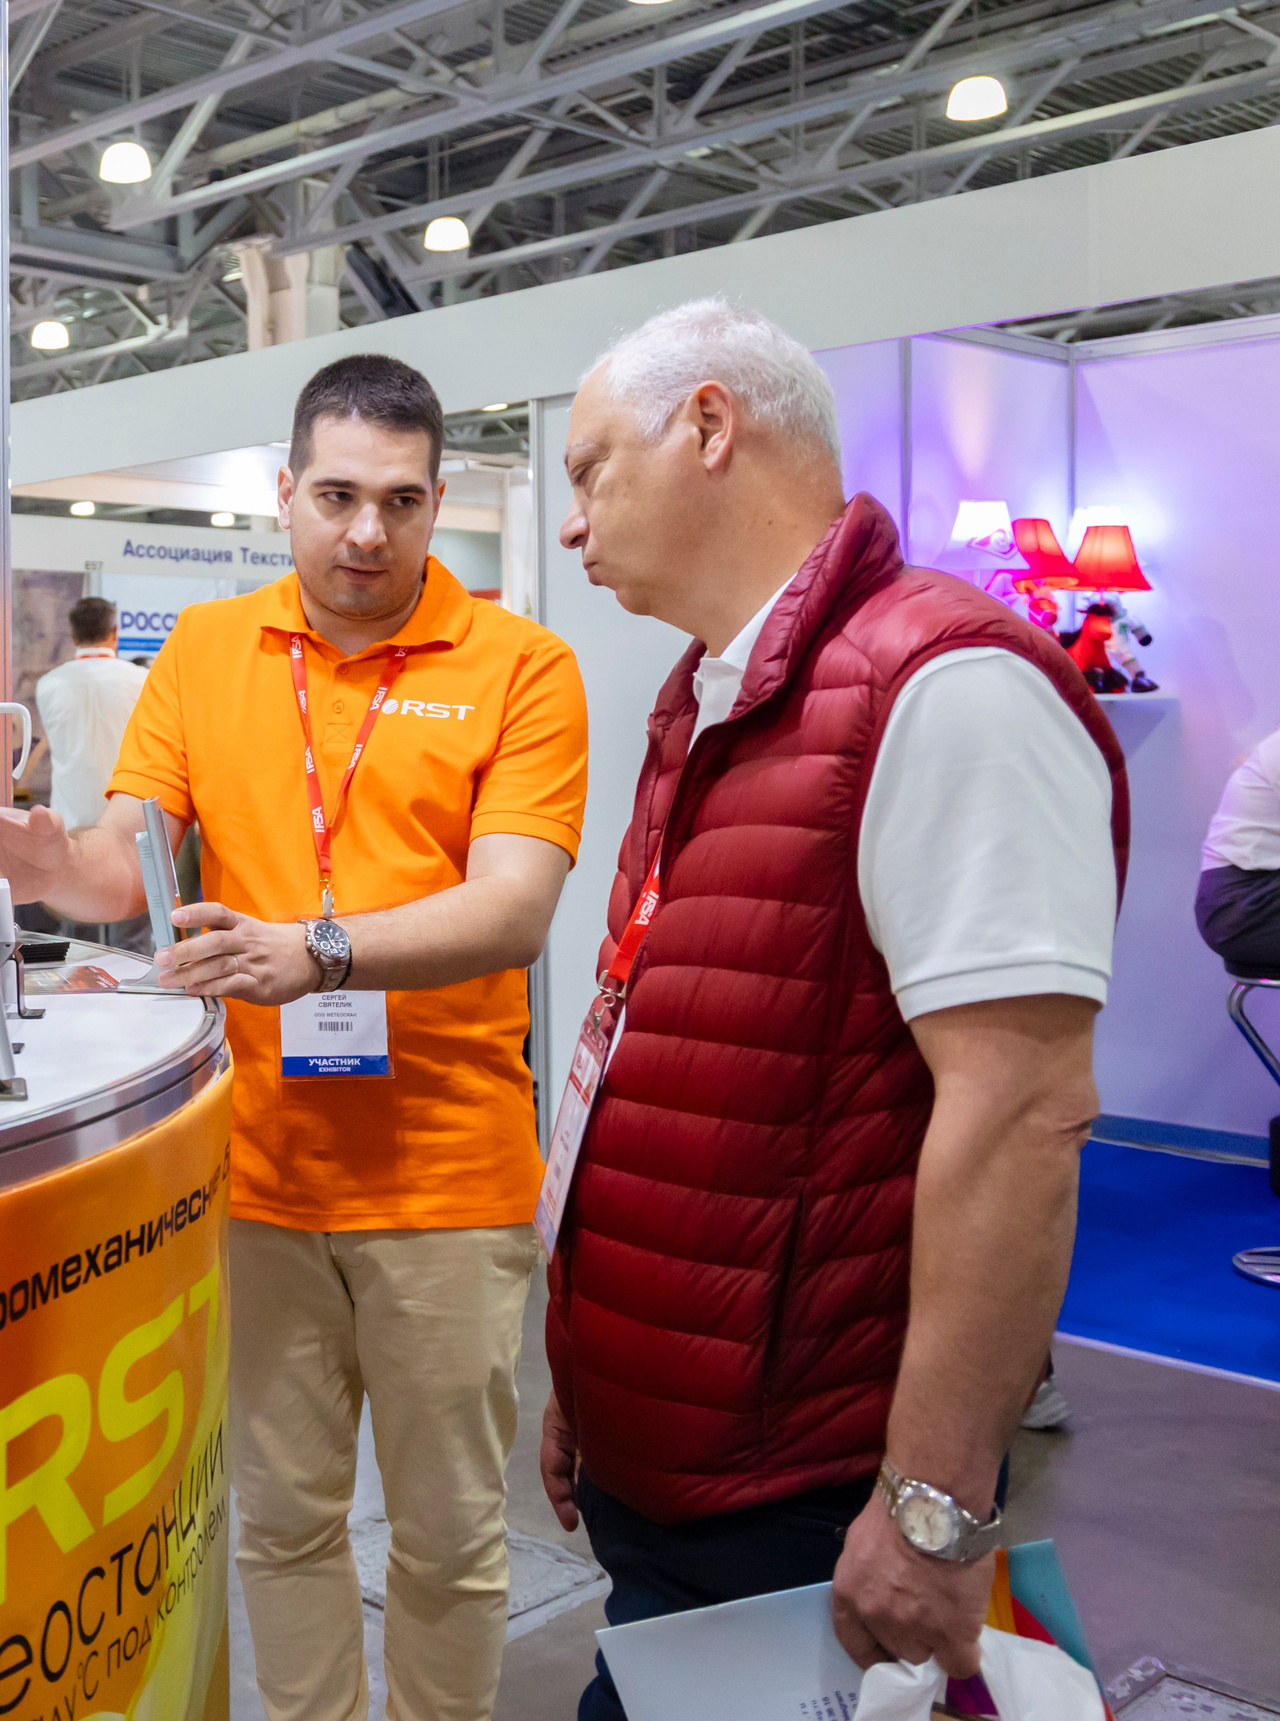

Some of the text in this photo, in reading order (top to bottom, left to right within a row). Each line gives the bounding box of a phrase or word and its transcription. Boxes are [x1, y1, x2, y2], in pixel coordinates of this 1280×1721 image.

[122, 539, 233, 565] Ассоциация
[369, 686, 388, 711] IFSA
[400, 699, 475, 720] RST
[312, 806, 325, 833] IFSA
[634, 889, 660, 926] IFSA
[308, 1058, 361, 1066] УЧАСТНИК
